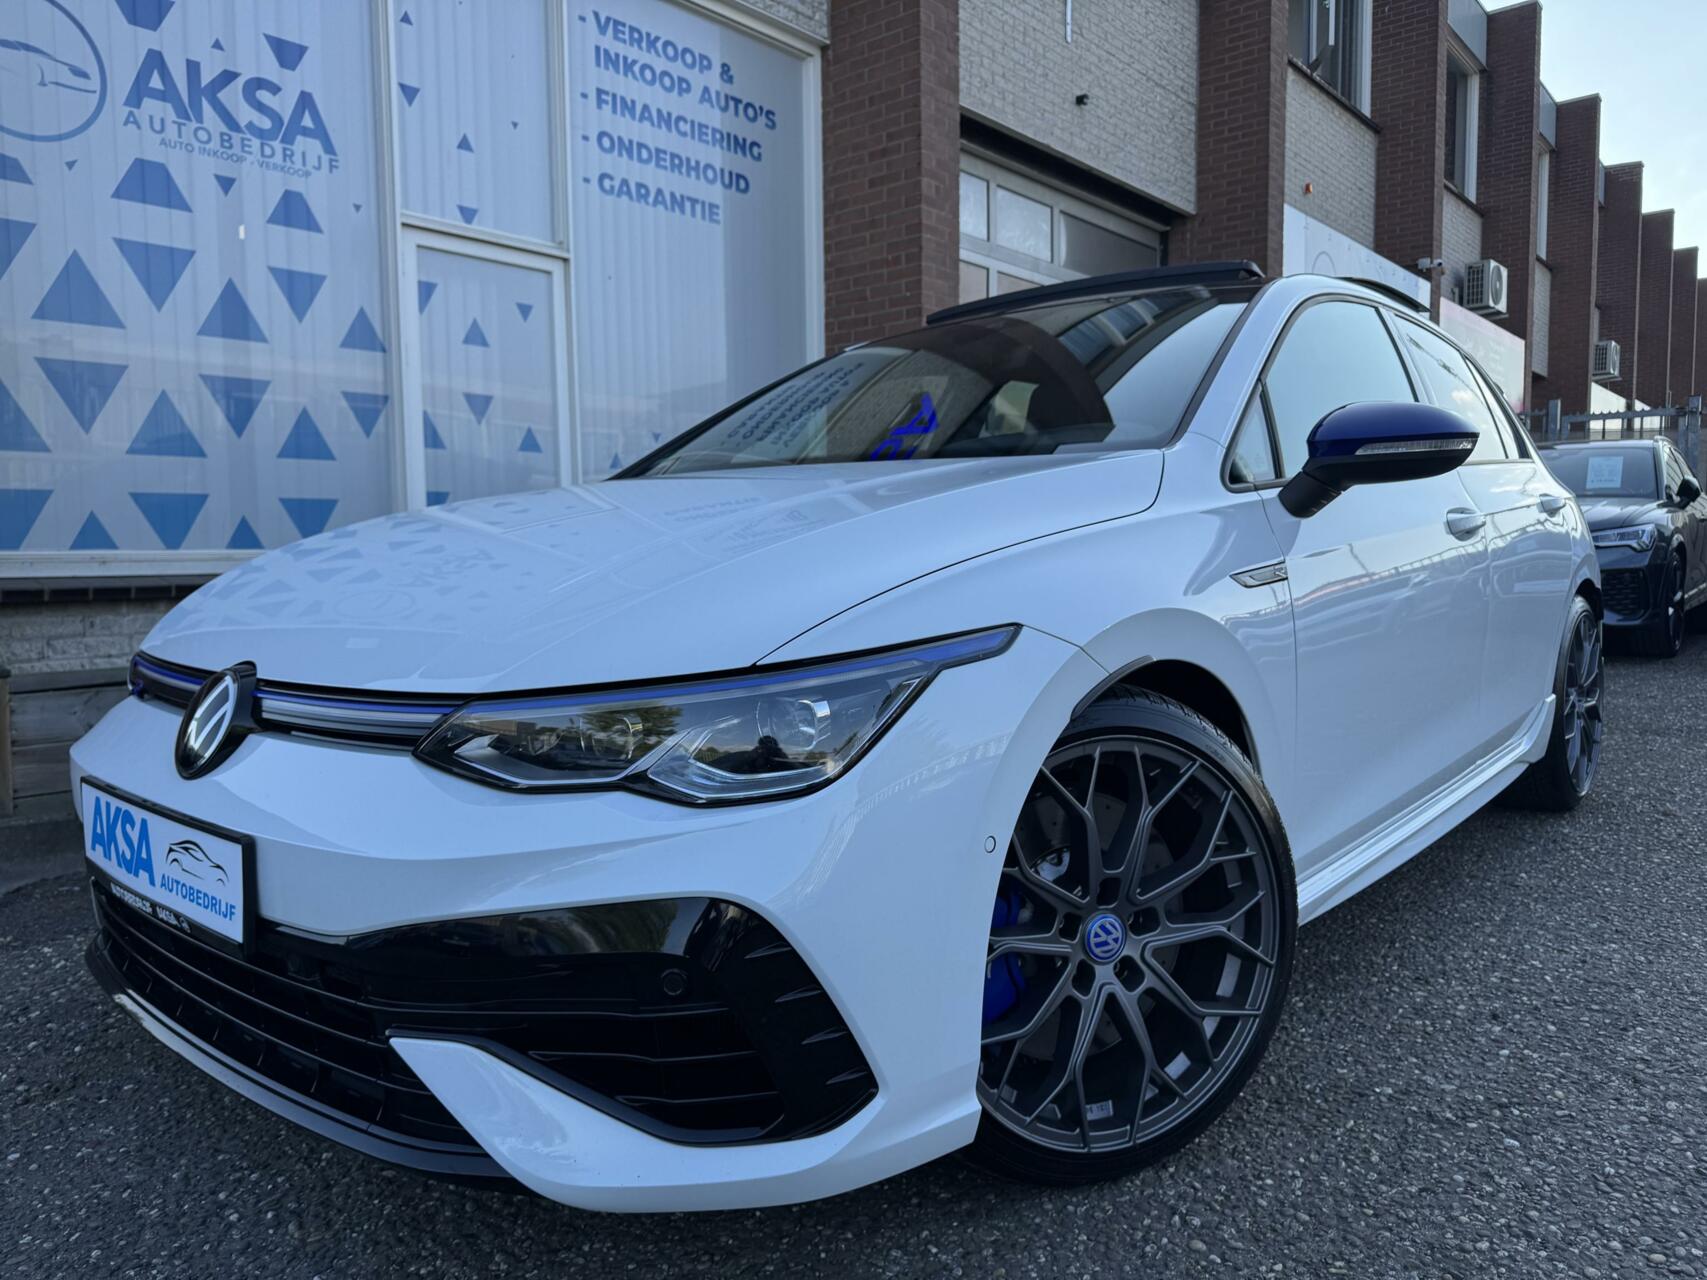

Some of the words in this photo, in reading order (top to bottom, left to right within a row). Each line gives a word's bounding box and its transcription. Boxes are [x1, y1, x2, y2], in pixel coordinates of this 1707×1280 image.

[592, 9, 712, 75] VERKOOP
[719, 62, 734, 85] &
[123, 47, 338, 157] AKSA
[594, 45, 692, 98] INKOOP
[698, 85, 777, 130] AUTO'S
[122, 110, 340, 174] AUTOBEDRIJF
[159, 137, 195, 154] AUTO
[198, 148, 248, 165] INKOOP
[256, 158, 312, 179] VERKOOP
[595, 87, 763, 162] FINANCIERING
[596, 130, 750, 194] ONDERHOUD
[597, 172, 721, 225] GARANTIE
[91, 795, 156, 888] AKSA
[159, 873, 236, 922] AUTOBEDRIJF
